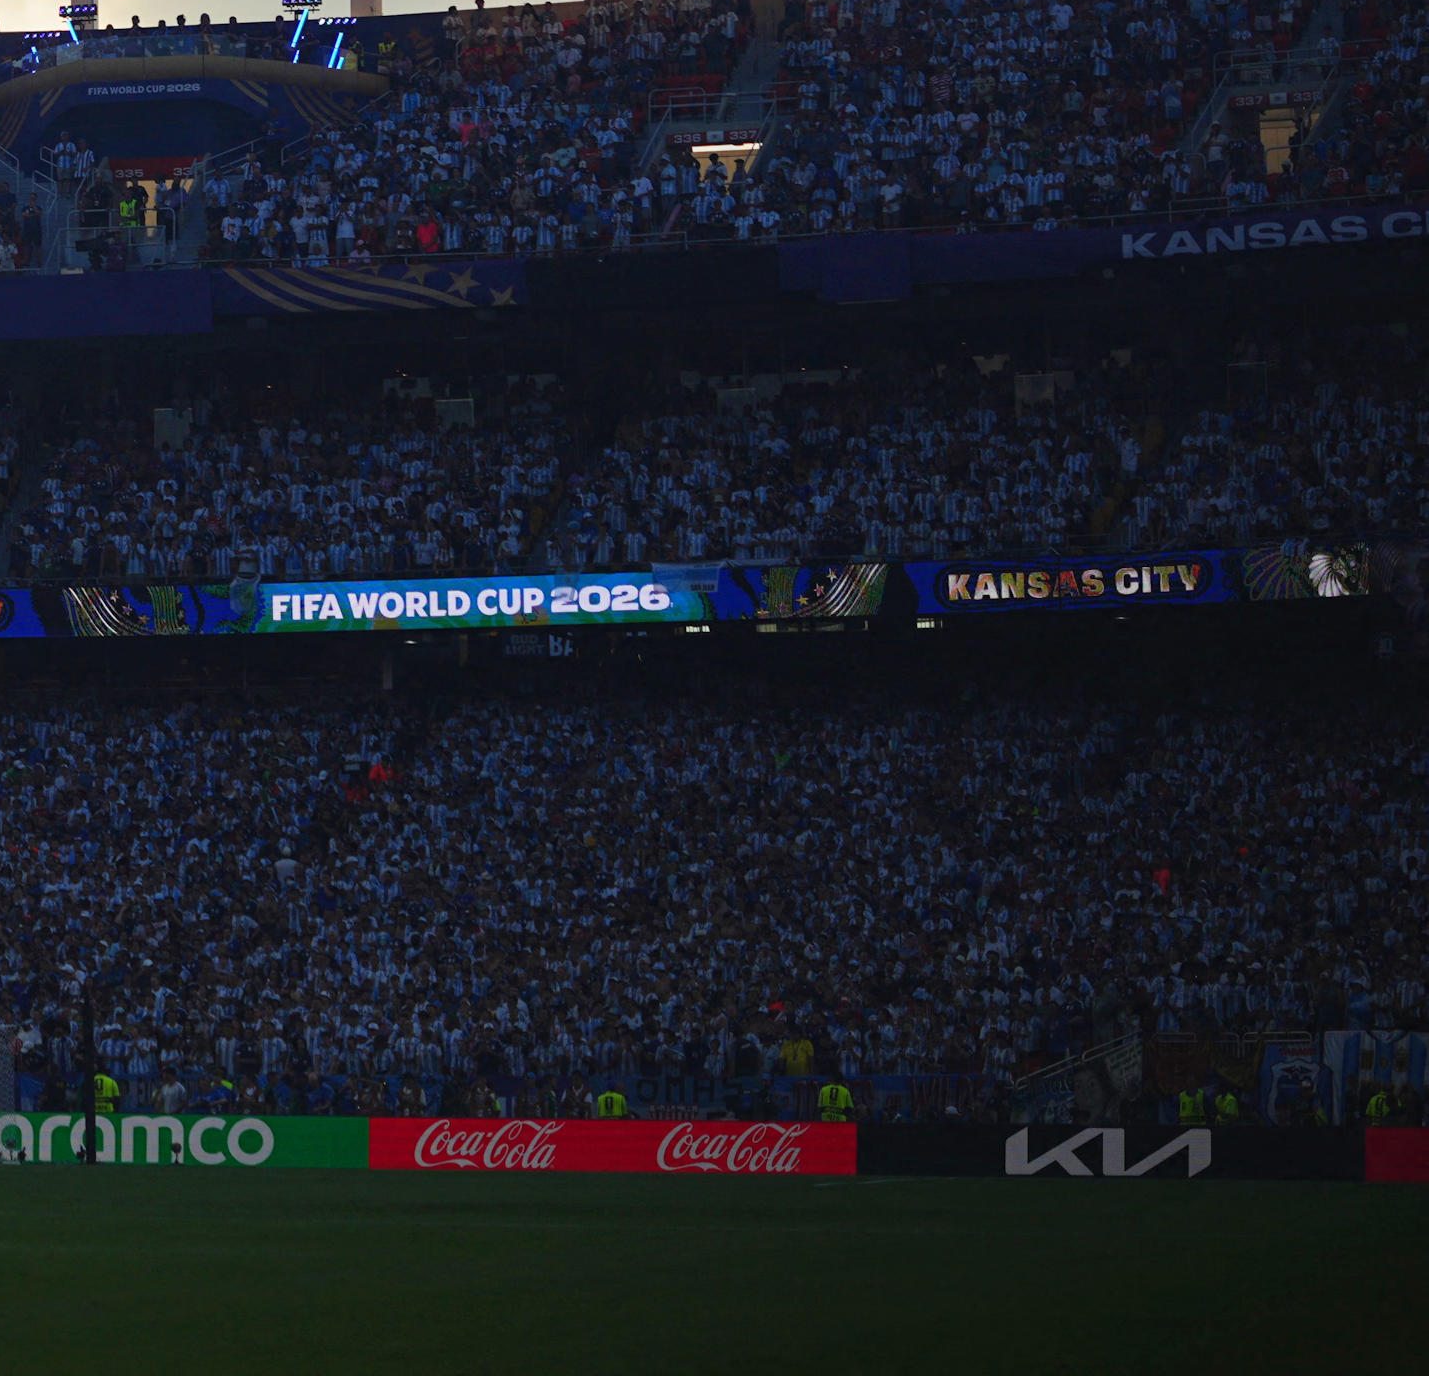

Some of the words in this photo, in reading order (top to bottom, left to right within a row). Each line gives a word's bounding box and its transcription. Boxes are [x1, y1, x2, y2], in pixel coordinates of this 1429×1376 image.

[87, 87, 109, 96] FIFA
[110, 86, 145, 95] WORLD
[146, 85, 166, 93] CUP
[166, 83, 201, 93] 2026
[673, 133, 702, 143] 336
[115, 169, 144, 178] 335
[1121, 215, 1368, 259] KANSAS
[948, 569, 1105, 600] KANSAS
[1115, 564, 1201, 595] CITY
[272, 594, 343, 621] FIFA
[347, 590, 471, 619] WORLD
[476, 587, 545, 615] CUP
[550, 584, 671, 613] 2026
[413, 1118, 565, 1170] Coca-Cola
[655, 1121, 811, 1174] Coca-Cola
